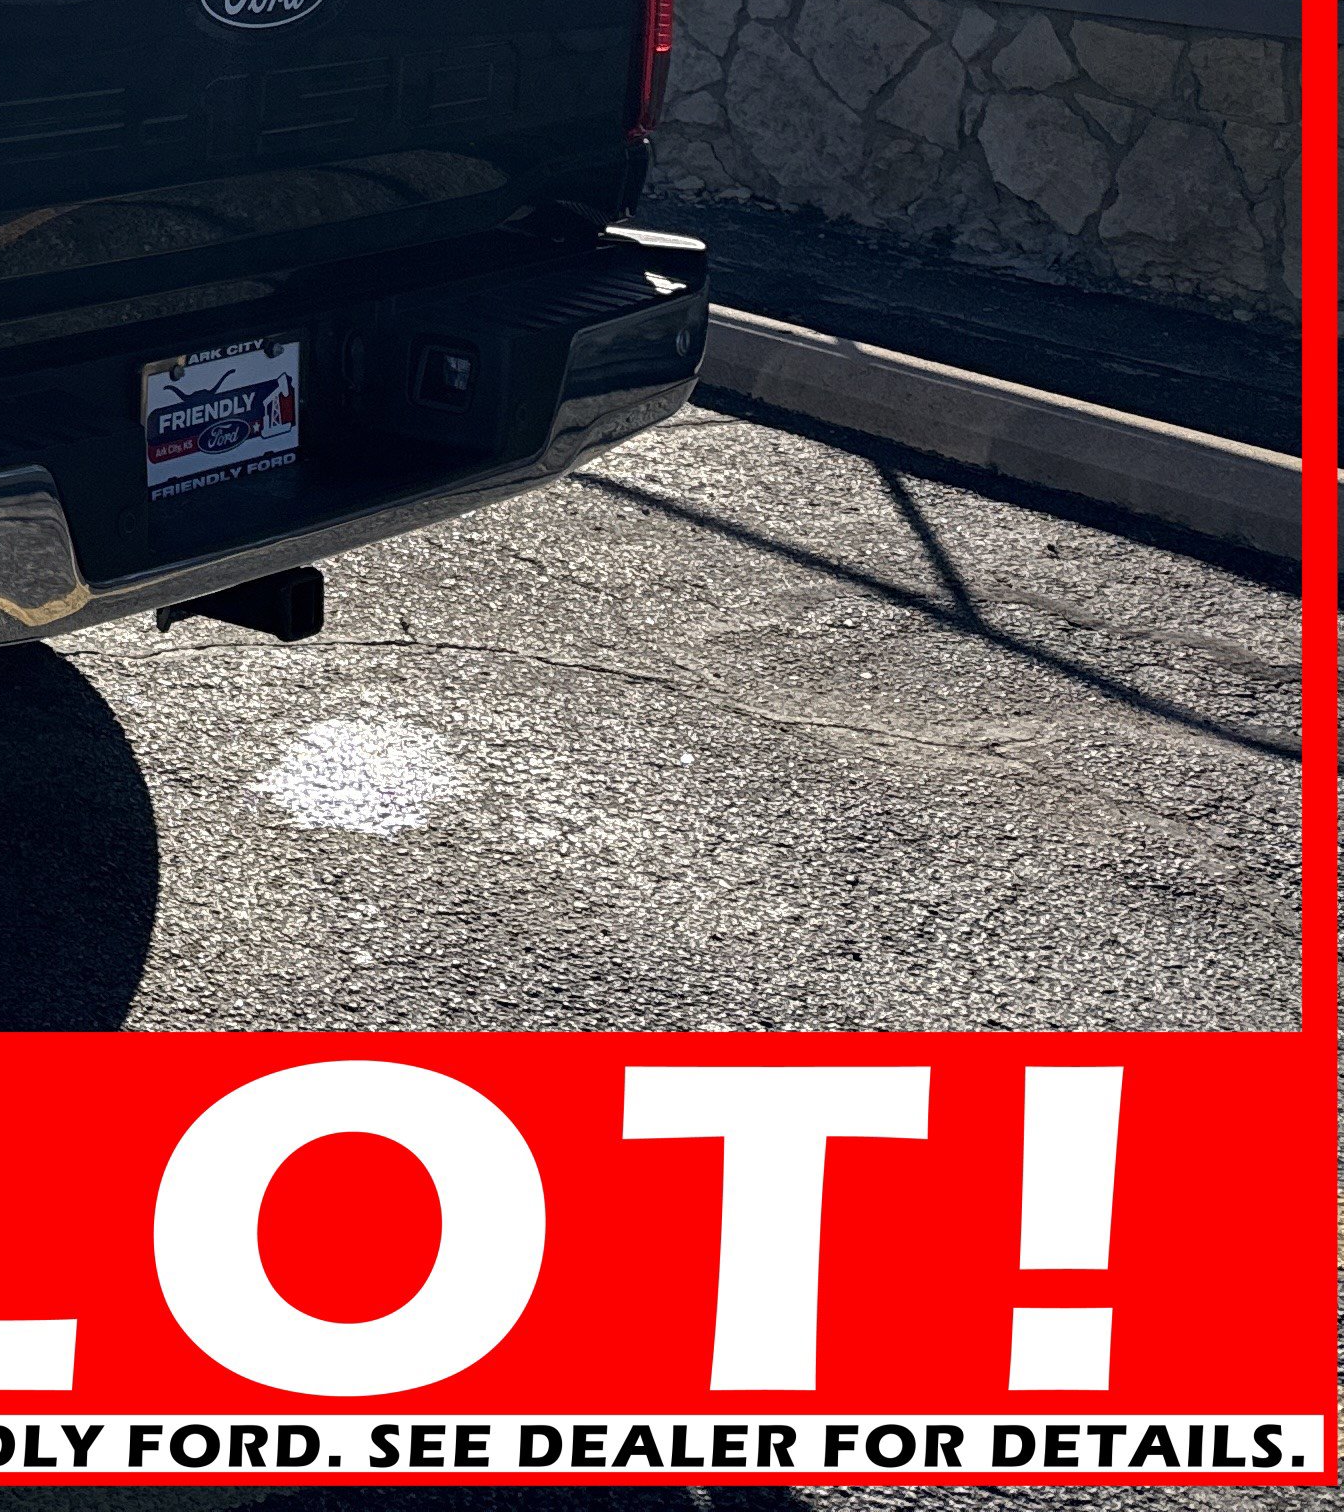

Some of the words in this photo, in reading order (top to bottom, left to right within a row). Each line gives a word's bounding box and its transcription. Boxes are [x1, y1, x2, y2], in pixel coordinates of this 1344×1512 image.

[188, 349, 222, 366] ARK
[226, 338, 264, 355] CITY
[158, 391, 256, 435] FRIENDLY
[208, 423, 240, 449] Ford
[151, 466, 243, 502] FRIENDLY
[246, 452, 297, 475] FORD
